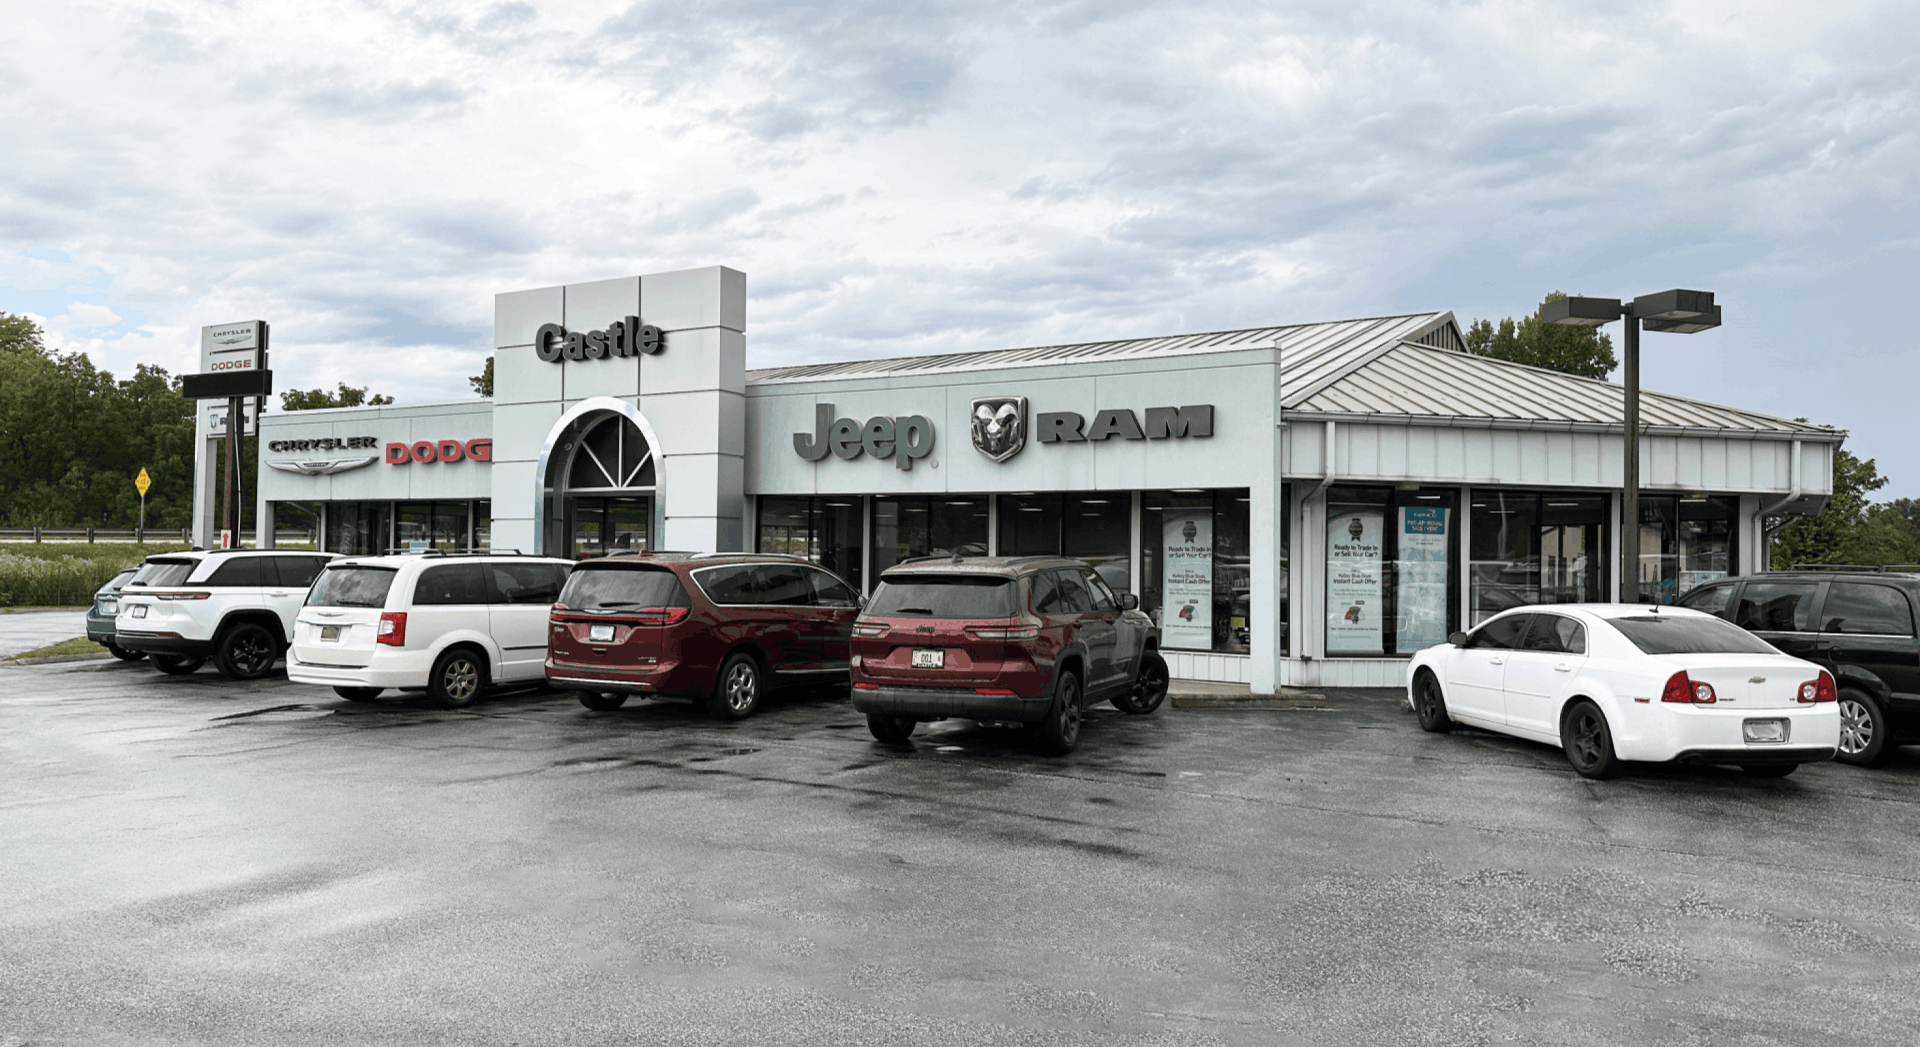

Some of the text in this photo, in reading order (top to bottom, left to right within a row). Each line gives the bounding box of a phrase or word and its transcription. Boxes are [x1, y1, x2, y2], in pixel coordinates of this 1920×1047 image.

[213, 328, 252, 338] CHRYSLER
[536, 315, 663, 363] Castle
[211, 359, 252, 371] DODGE
[1037, 404, 1215, 444] RAM
[268, 436, 378, 453] CHRYSLER
[793, 403, 936, 472] Jeep
[386, 438, 493, 465] DODG
[1168, 545, 1184, 553] Ready
[921, 653, 932, 663] 001
